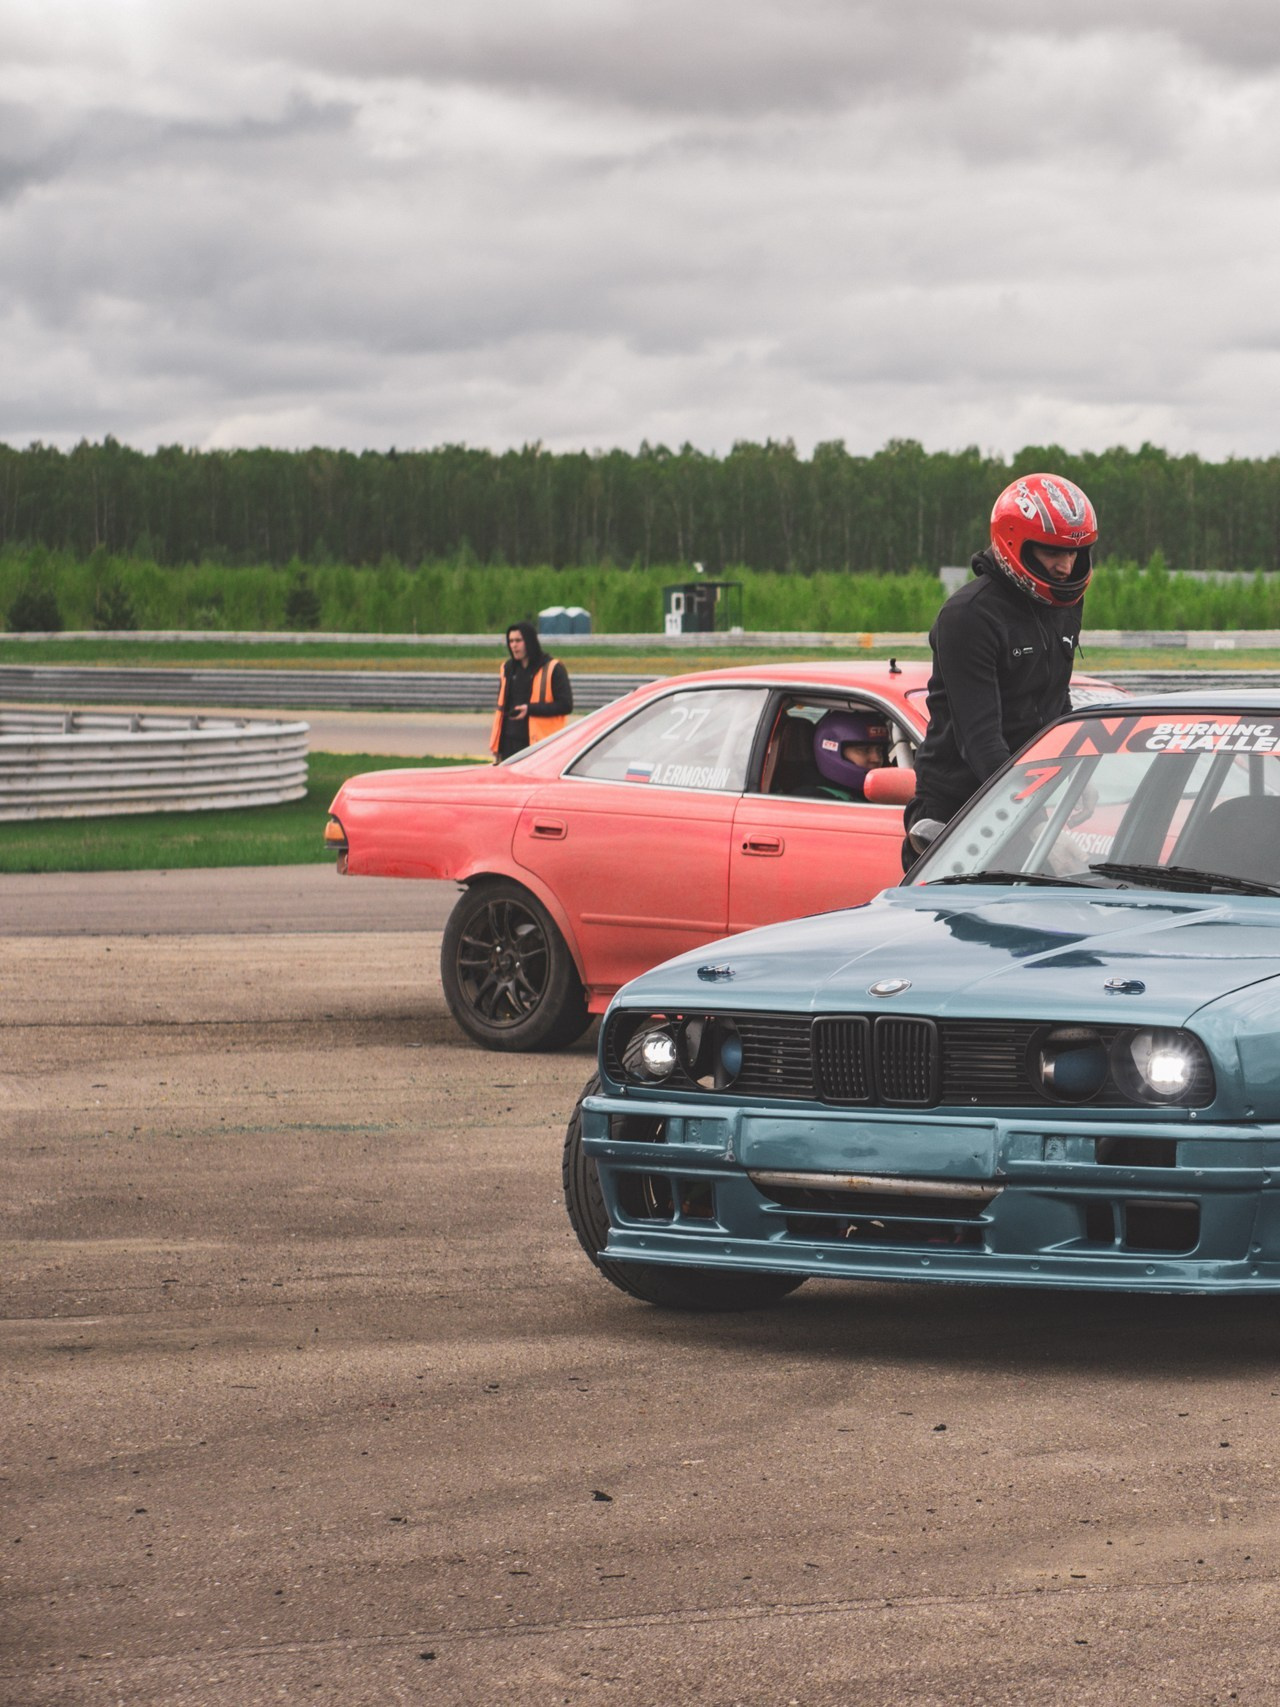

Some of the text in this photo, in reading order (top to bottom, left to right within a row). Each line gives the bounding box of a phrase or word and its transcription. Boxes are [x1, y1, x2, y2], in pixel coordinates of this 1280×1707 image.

[660, 707, 711, 742] 27
[1152, 722, 1275, 737] BURNING
[650, 762, 730, 789] A.ERMOSHIN
[1014, 766, 1063, 800] 7
